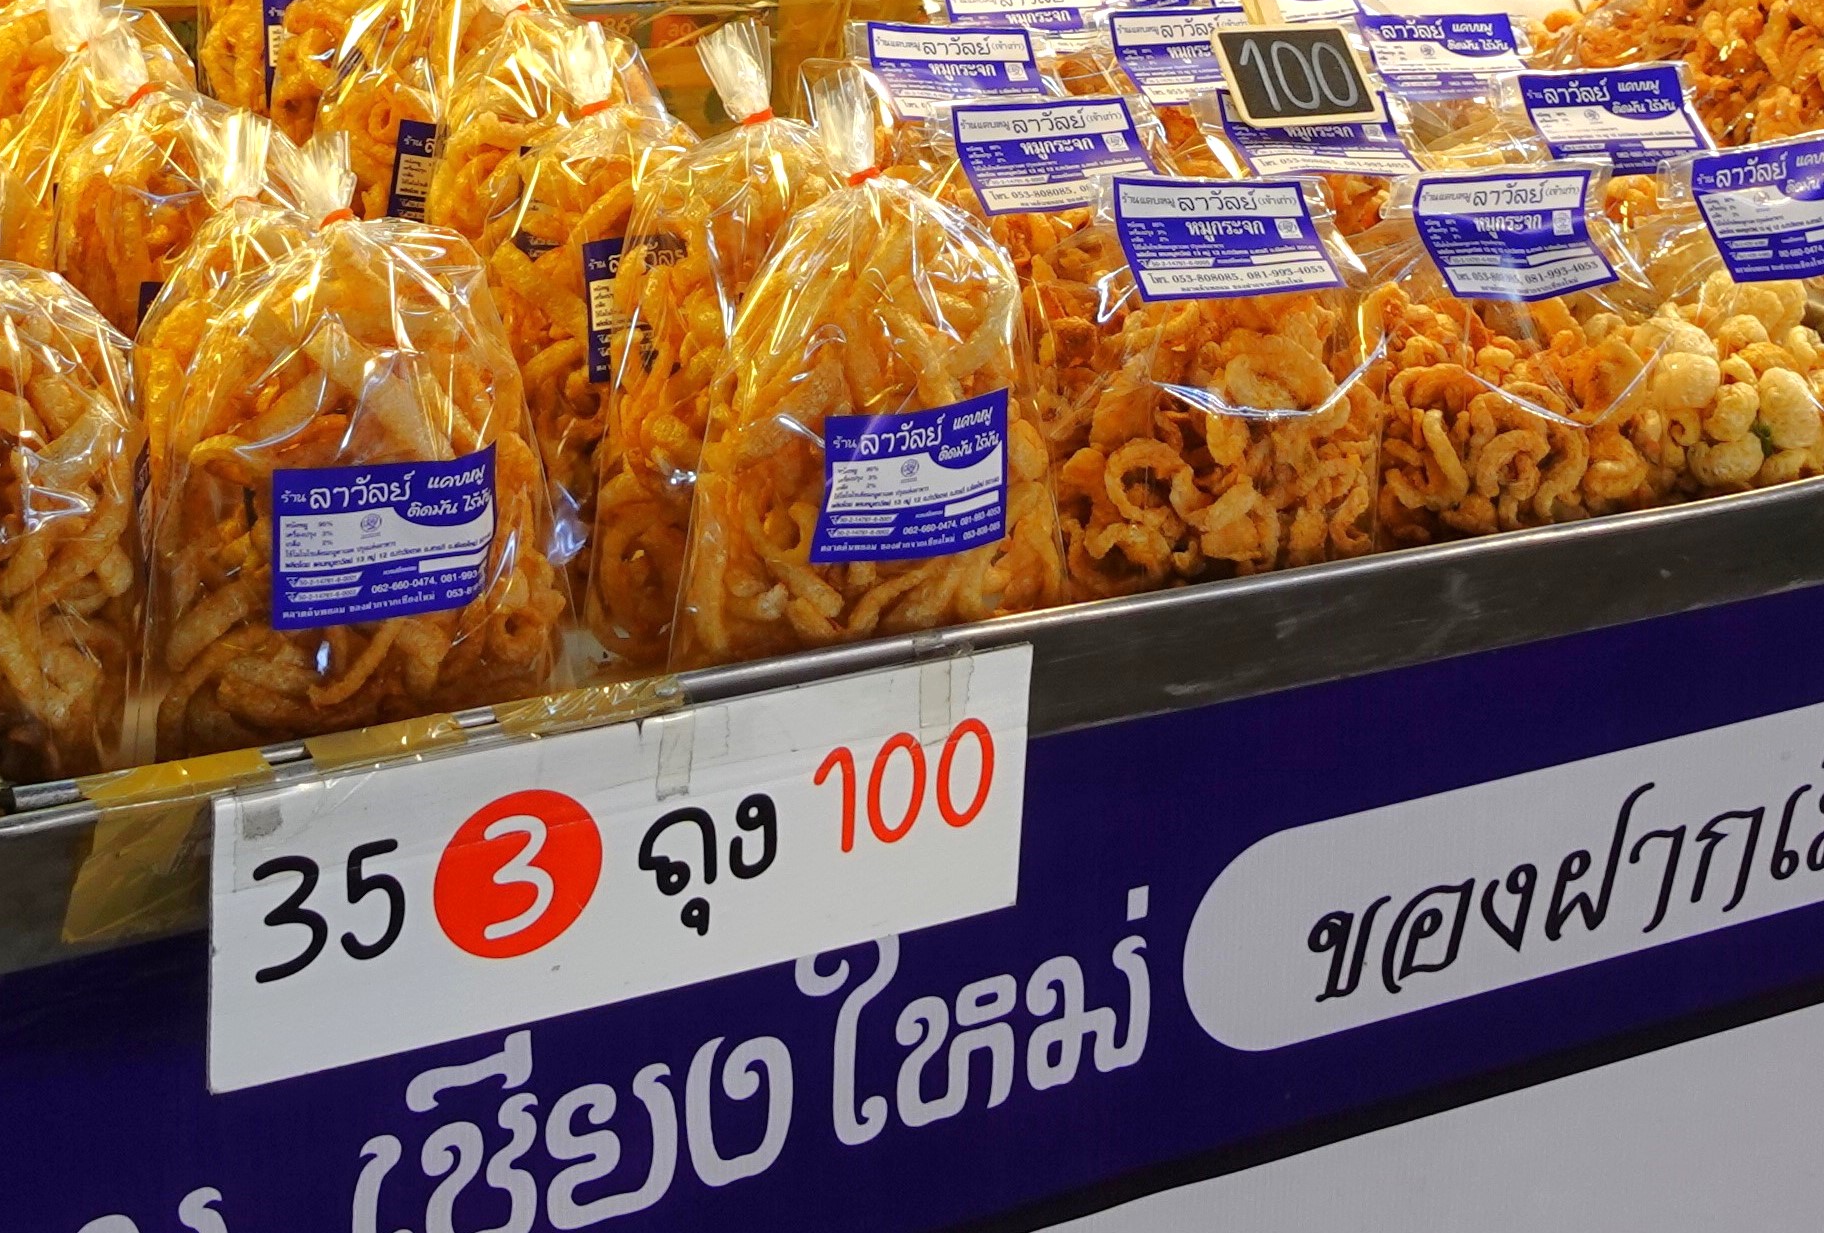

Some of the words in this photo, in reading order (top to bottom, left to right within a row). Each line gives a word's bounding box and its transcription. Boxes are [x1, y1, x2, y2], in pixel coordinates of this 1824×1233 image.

[1379, 18, 1446, 41] ลาวัลย์
[922, 35, 992, 57] ลาวัลย์
[928, 62, 997, 83] หมูกระจก
[1238, 38, 1360, 113] 100
[1543, 76, 1610, 105] ลาวัลย์
[1012, 107, 1086, 135] ลาวัลย์
[1019, 136, 1095, 160] หมูกระจก
[1715, 151, 1789, 189] ลาวัลย์
[1177, 188, 1258, 212] ลาวัลย์
[1472, 179, 1549, 207] ลาวัลย์
[1184, 218, 1266, 243] หมูกระจก
[1474, 214, 1543, 240] หมูกระจก
[1246, 265, 1326, 280] 081-993-4053
[952, 406, 994, 431] แคบหมู
[833, 435, 858, 450] ร้าน
[859, 413, 946, 456] ลาวัลย์
[937, 440, 973, 462] ติดมัน
[427, 464, 486, 490] แคบหมู
[280, 490, 307, 505] ร้าน
[308, 470, 416, 510] ลาวัลย์
[406, 500, 458, 519] ติดมัน
[370, 576, 438, 594] 062-660-0474,
[440, 569, 481, 584] 081-993
[252, 838, 406, 983] 35
[481, 813, 557, 942] 3
[638, 791, 780, 935] ถุง
[812, 717, 996, 855] 100
[352, 885, 1152, 1233] เชียงใหม่
